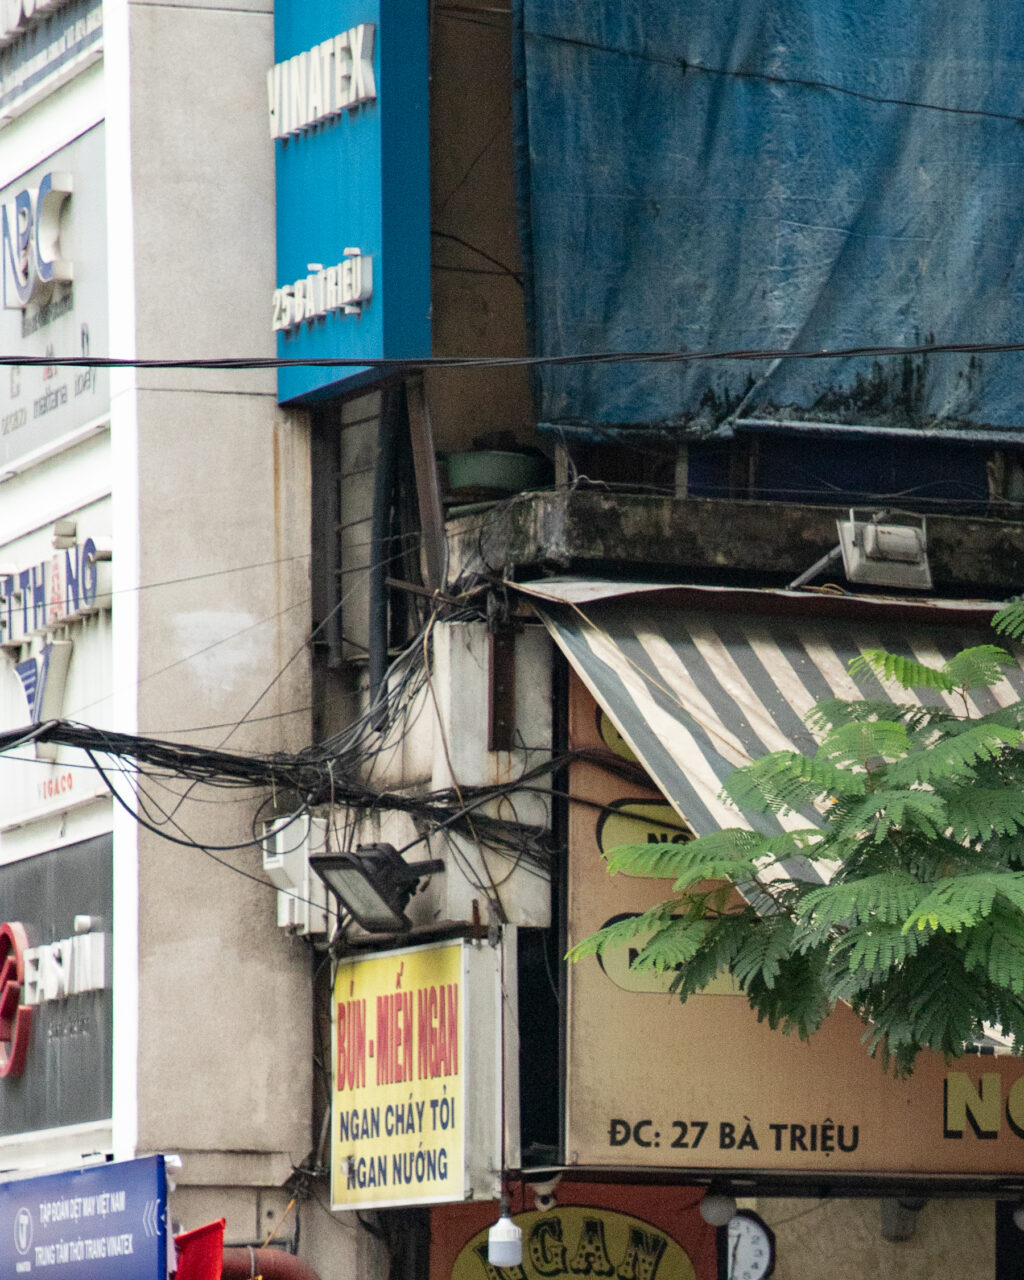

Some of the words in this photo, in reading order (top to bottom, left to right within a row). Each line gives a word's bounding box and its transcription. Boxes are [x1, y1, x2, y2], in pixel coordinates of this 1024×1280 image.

[267, 22, 377, 140] VINATEX
[272, 284, 294, 331] 25
[337, 980, 367, 1091] BÚN
[376, 961, 414, 1086] MIẾN
[418, 983, 458, 1081] NGAN
[340, 1106, 380, 1143] NGAN
[385, 1092, 425, 1137] CHÁY
[430, 1084, 456, 1131] TỎI
[607, 1119, 661, 1148] ĐC:
[671, 1120, 709, 1149] 27
[719, 1115, 759, 1150] BÀ
[769, 1117, 859, 1157] TRIỆU
[347, 1155, 388, 1190] NGAN
[393, 1141, 448, 1186] NƯỚNG
